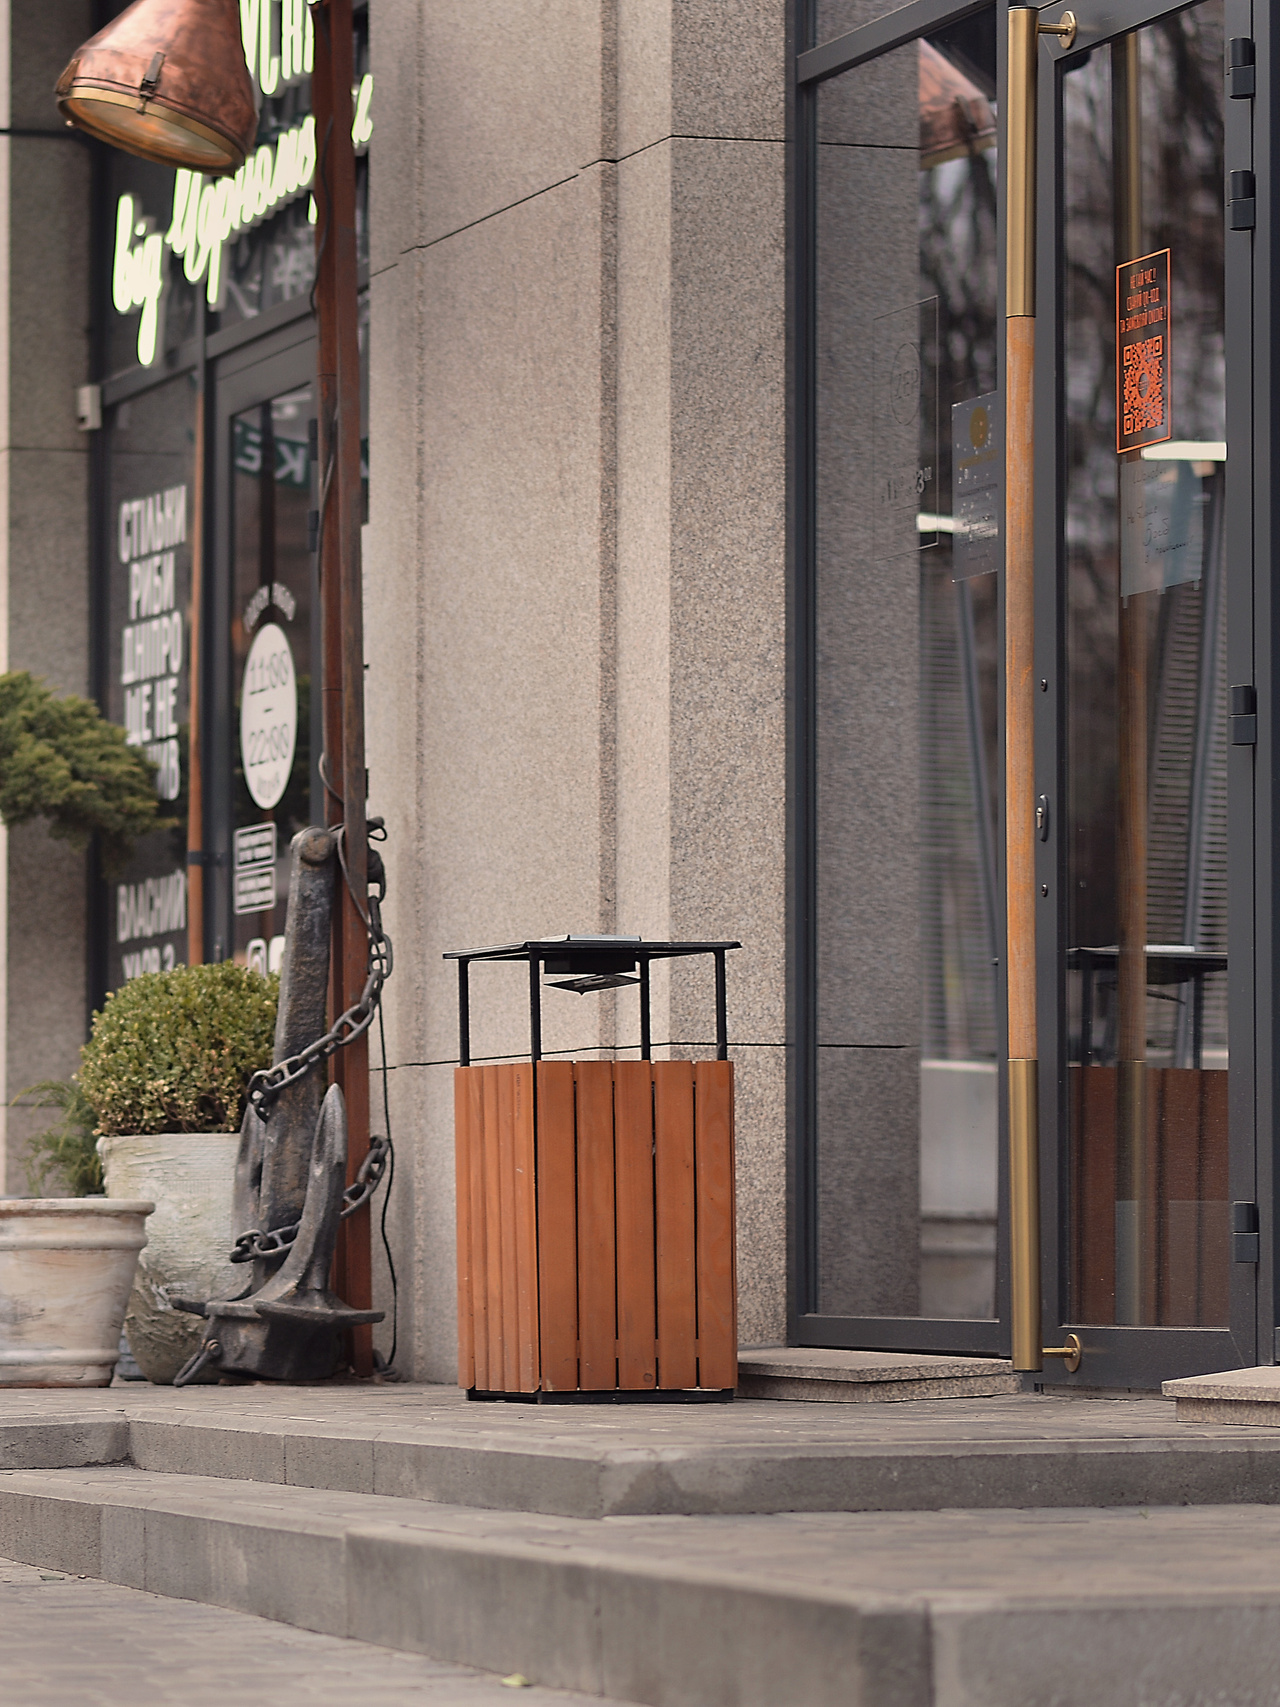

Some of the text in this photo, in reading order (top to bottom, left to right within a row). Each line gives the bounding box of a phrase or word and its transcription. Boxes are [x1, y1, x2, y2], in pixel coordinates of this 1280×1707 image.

[120, 484, 186, 563] СТІЛЬКИ
[130, 551, 175, 620] РИБИ
[122, 610, 182, 685] ДНІПРО
[154, 677, 178, 738] НЕ
